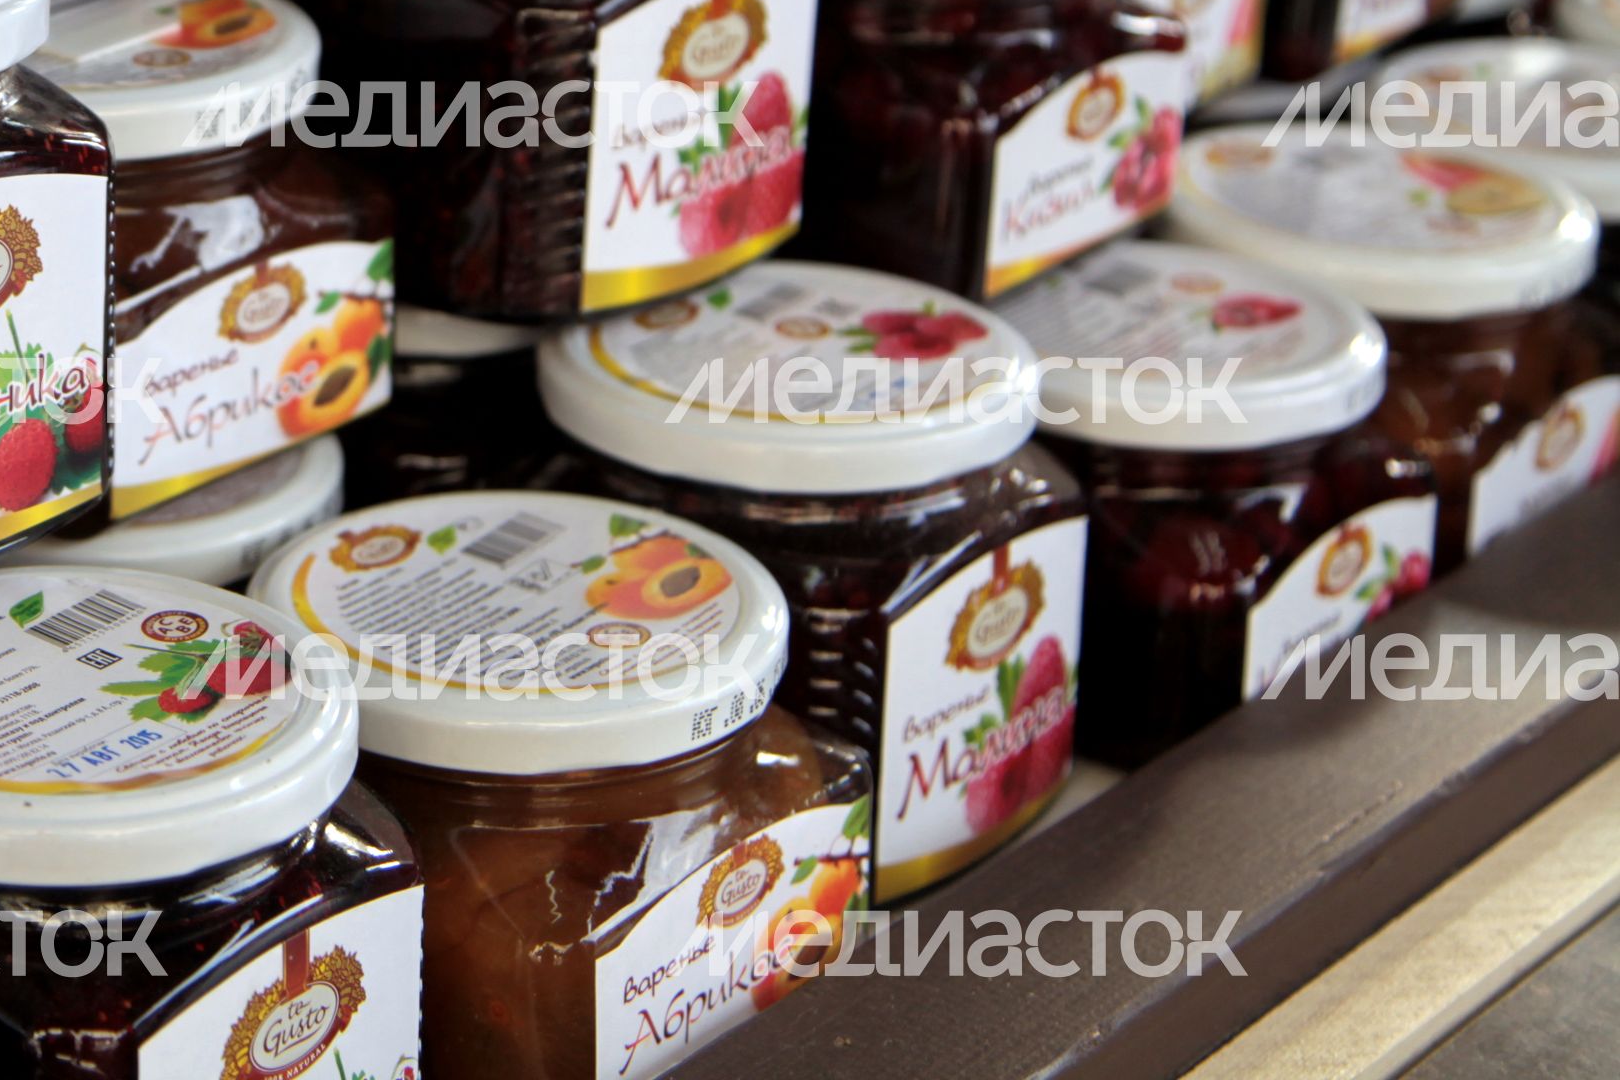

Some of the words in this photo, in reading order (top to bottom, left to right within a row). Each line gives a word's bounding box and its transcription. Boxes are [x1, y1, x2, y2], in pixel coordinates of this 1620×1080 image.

[81, 745, 121, 767] АВГ
[120, 729, 163, 750] 2015
[897, 686, 1069, 821] Малина
[288, 1001, 311, 1019] te
[619, 936, 796, 1076] Абрикос
[263, 1006, 330, 1058] Gusto
[285, 1043, 326, 1078] NATURAL
